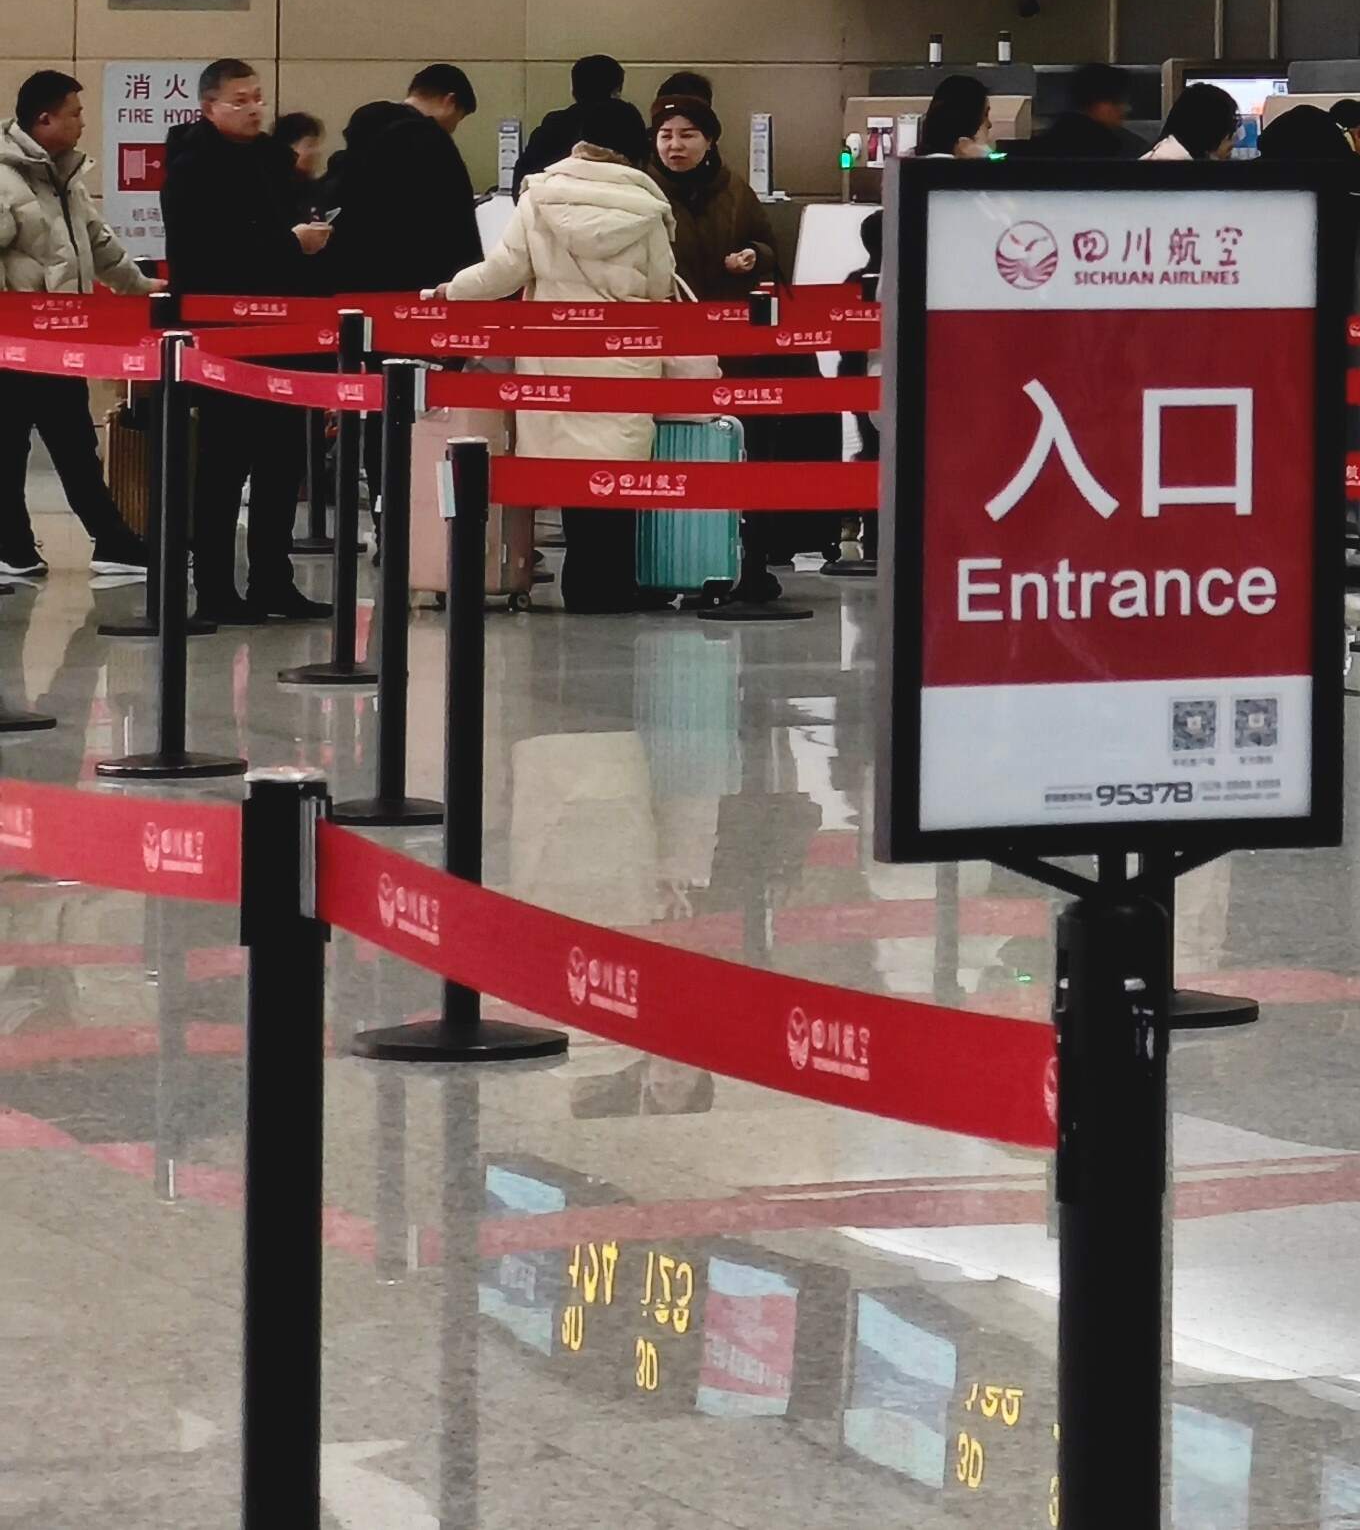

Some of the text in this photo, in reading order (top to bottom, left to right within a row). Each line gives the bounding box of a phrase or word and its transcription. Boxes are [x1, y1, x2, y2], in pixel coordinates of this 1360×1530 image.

[118, 108, 154, 124] FIRE
[1072, 226, 1244, 267] 四川航空
[1073, 269, 1241, 286] SICHUAN AIRLINES
[984, 378, 1253, 522] 入口
[957, 558, 1277, 622] Entrance
[1096, 781, 1193, 806] 95378
